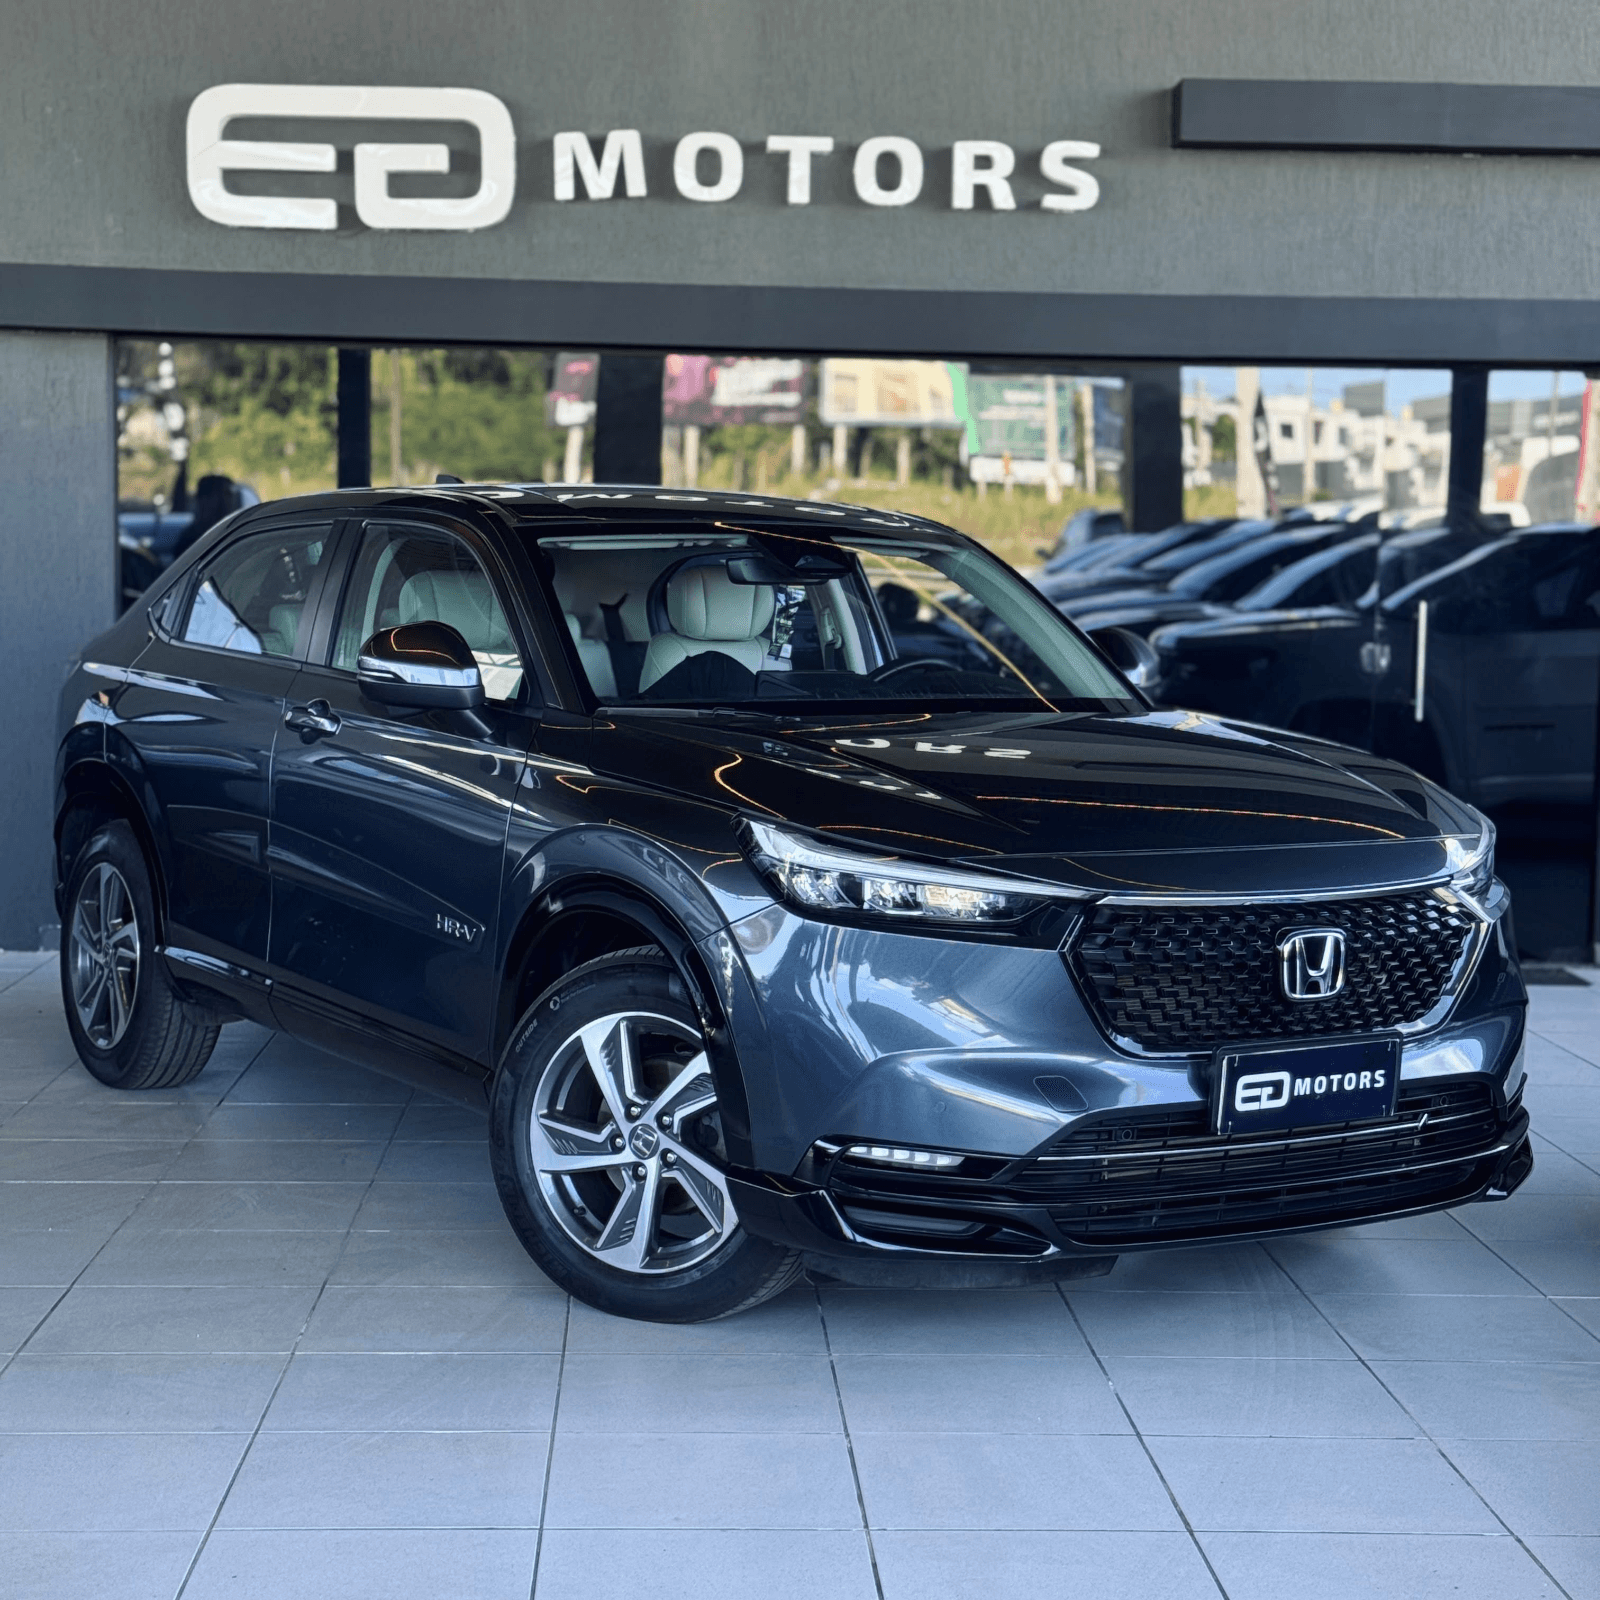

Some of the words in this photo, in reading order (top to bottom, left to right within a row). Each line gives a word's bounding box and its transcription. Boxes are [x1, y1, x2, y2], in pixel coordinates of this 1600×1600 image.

[553, 129, 1101, 212] MOTORS
[436, 913, 477, 942] HR-V
[515, 1018, 538, 1053] OUTSIDE
[1294, 1069, 1386, 1096] MOTORS
